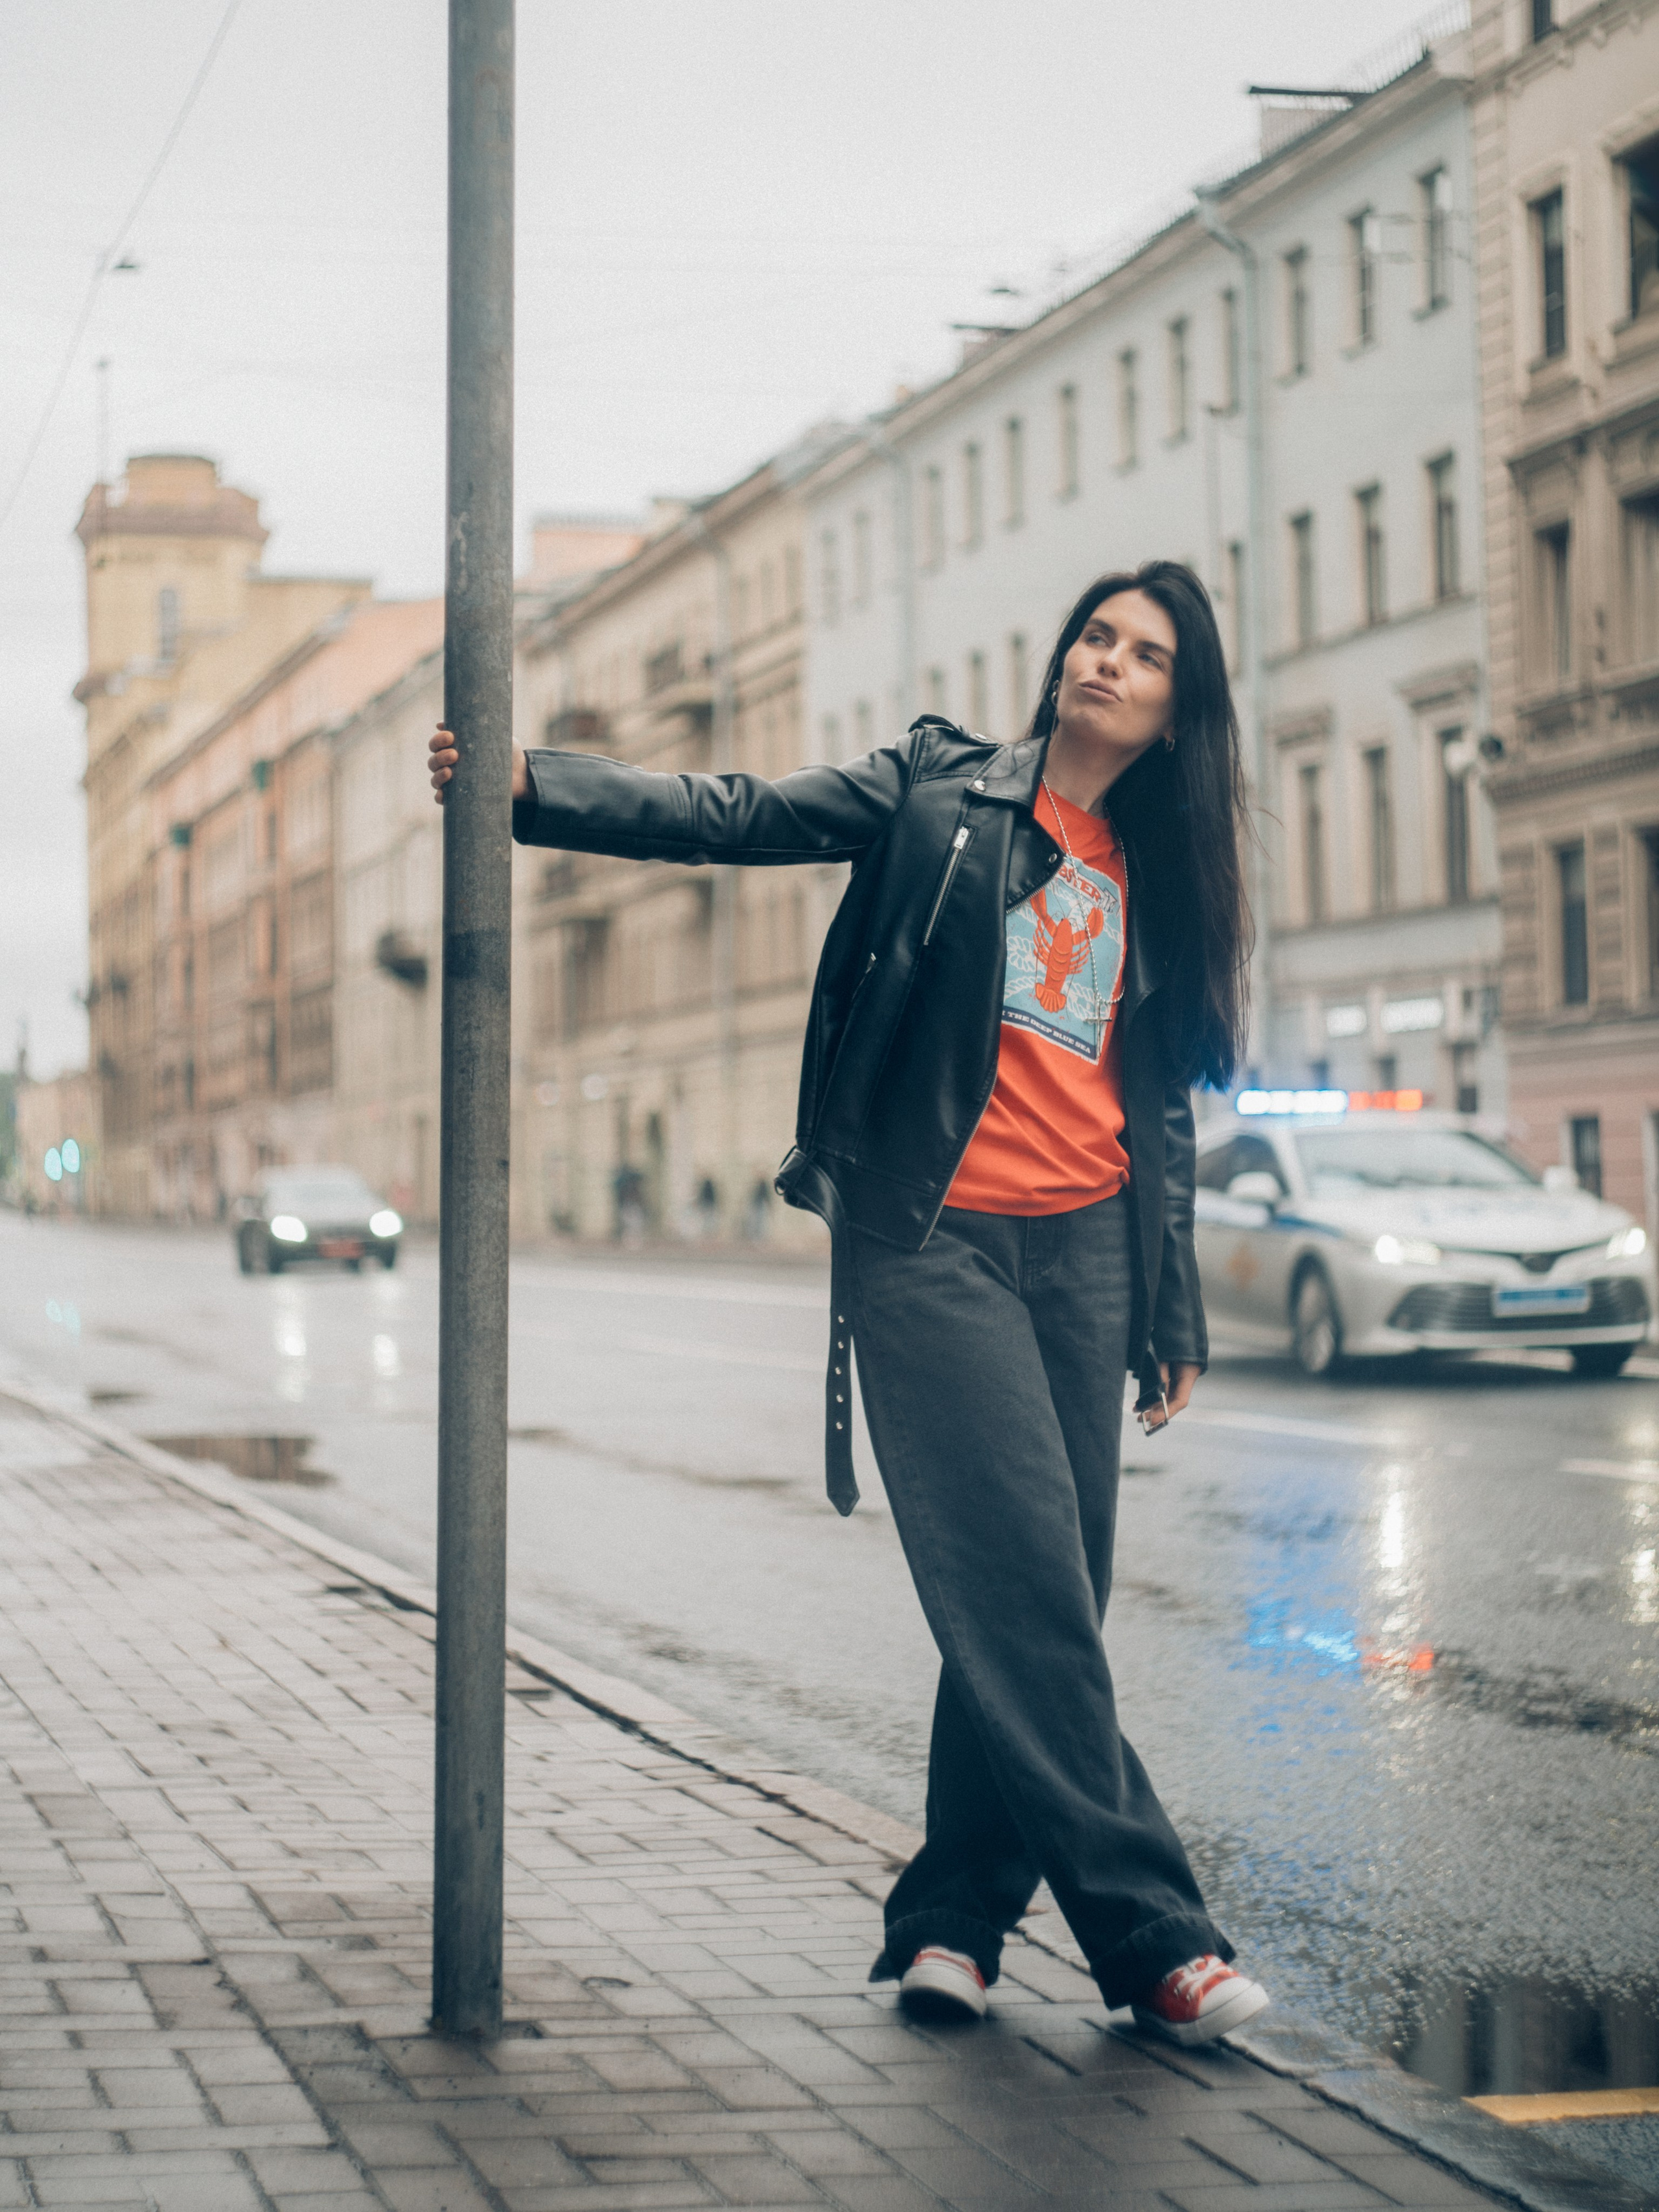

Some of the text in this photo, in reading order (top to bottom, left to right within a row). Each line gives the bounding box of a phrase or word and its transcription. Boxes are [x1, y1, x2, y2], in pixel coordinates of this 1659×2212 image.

[1007, 1012, 1091, 1053] THE DEEP BLUE SEA
